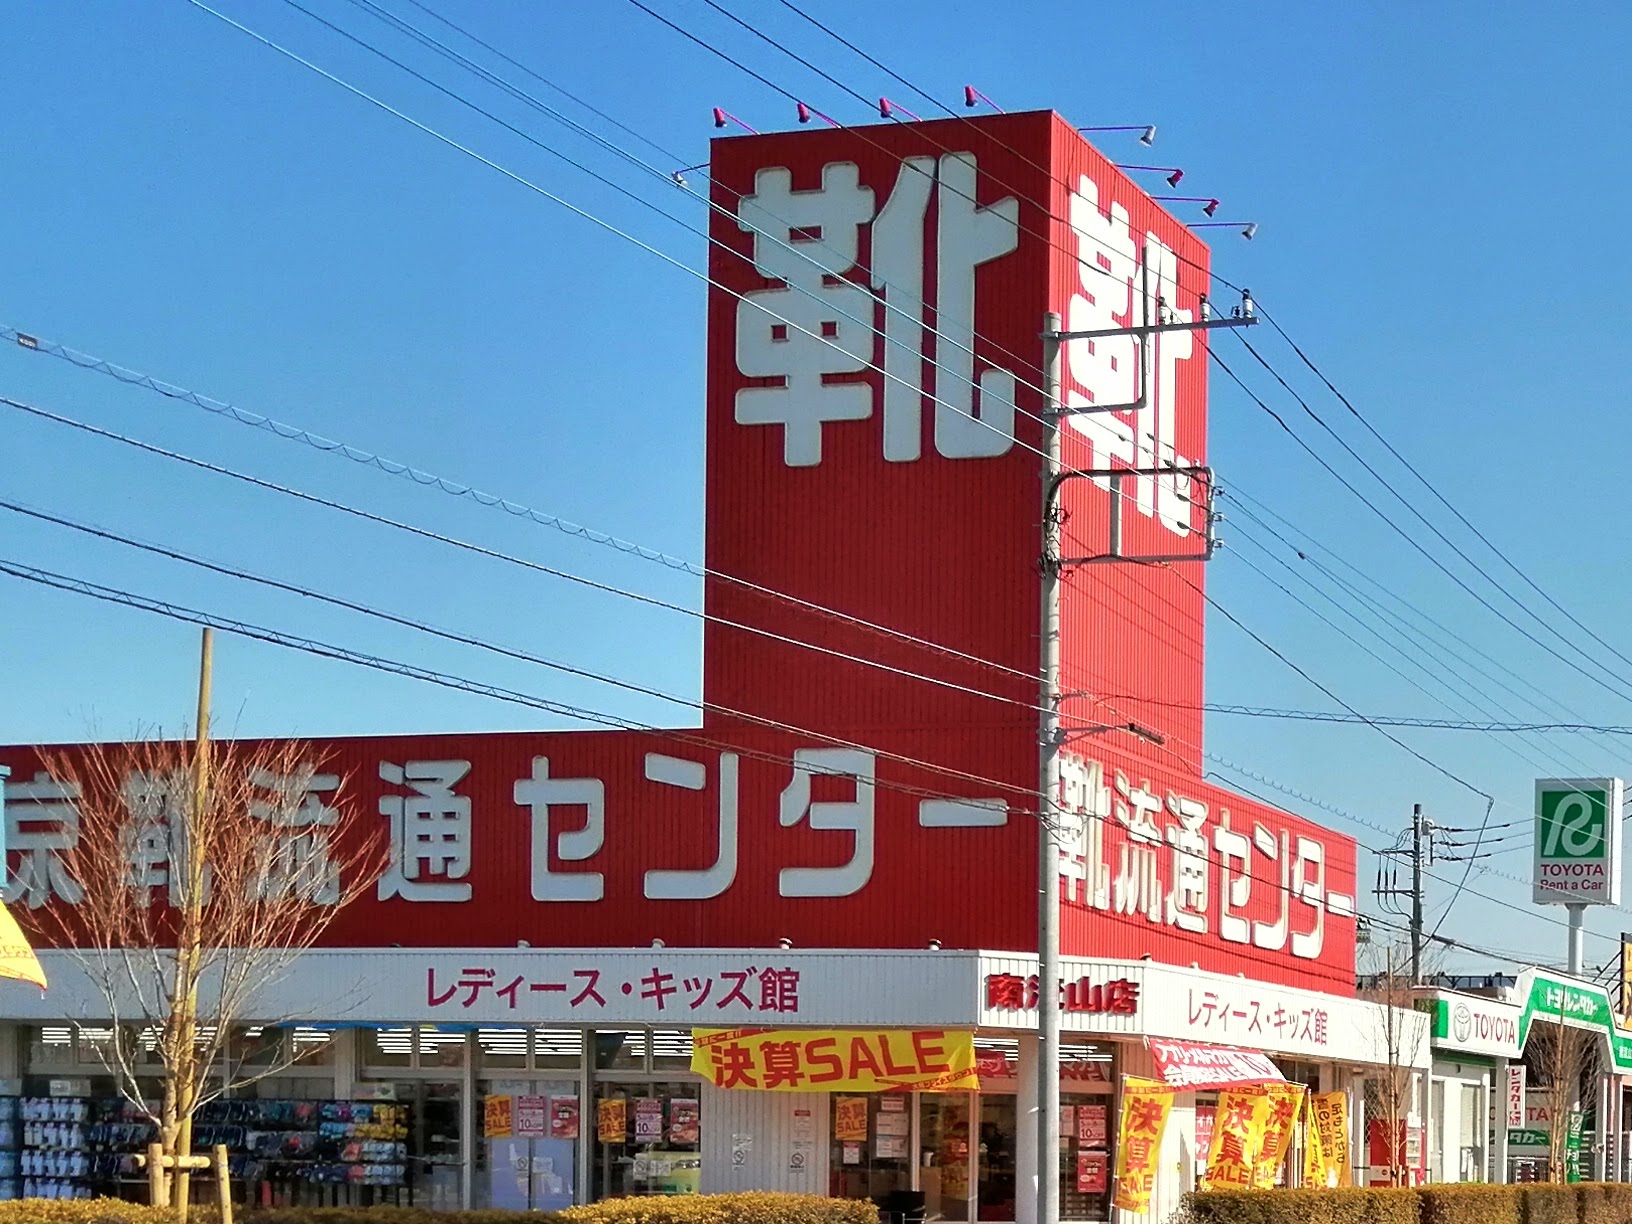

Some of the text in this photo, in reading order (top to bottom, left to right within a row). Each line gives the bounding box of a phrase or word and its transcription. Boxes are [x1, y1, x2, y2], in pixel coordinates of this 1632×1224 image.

[735, 151, 1019, 468] 靴
[1067, 174, 1193, 538] 靴
[1058, 751, 1354, 959] 靴流通センター
[1540, 864, 1605, 876] TOYOTA
[1540, 879, 1604, 890] Rent a Car
[427, 967, 801, 1013] レディース・キッズ館
[1189, 988, 1328, 1046] レディース・キッズ館
[1474, 1012, 1516, 1044] TOYOTA
[711, 1030, 951, 1089] 決算SALE
[485, 1101, 511, 1117] 決算
[600, 1104, 626, 1123] 決算
[836, 1103, 867, 1122] 決算
[487, 1116, 512, 1129] SALE
[601, 1121, 626, 1133] SALE
[837, 1119, 867, 1132] SALE
[1126, 1096, 1163, 1173] 決算
[1216, 1095, 1254, 1169] 決算
[1206, 1166, 1249, 1185] SALE
